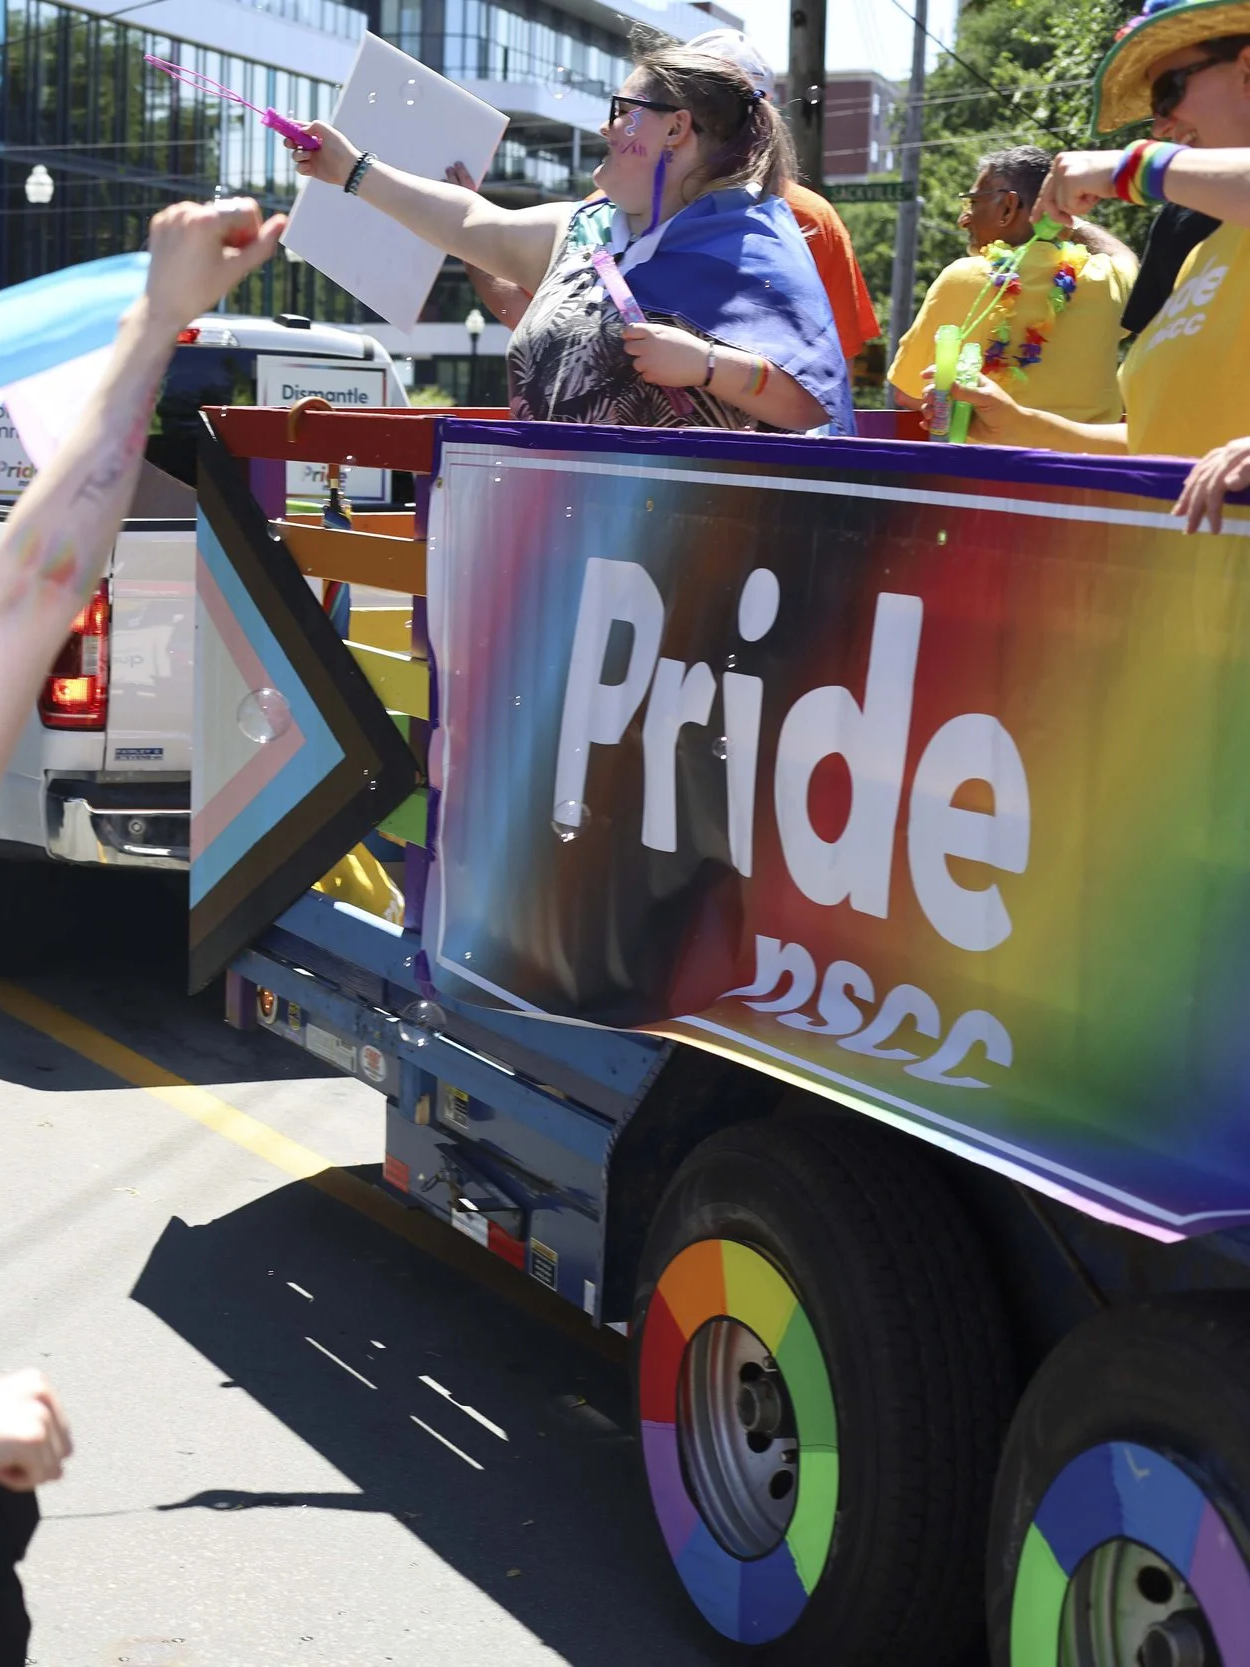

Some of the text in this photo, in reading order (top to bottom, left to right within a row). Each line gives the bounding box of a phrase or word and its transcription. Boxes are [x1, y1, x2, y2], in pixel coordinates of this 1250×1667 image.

[832, 186, 903, 200] SACKVILLE
[282, 384, 368, 404] Dismantle
[302, 465, 348, 483] Prie
[553, 557, 1030, 952] Pride
[717, 933, 1014, 1088] nscc
